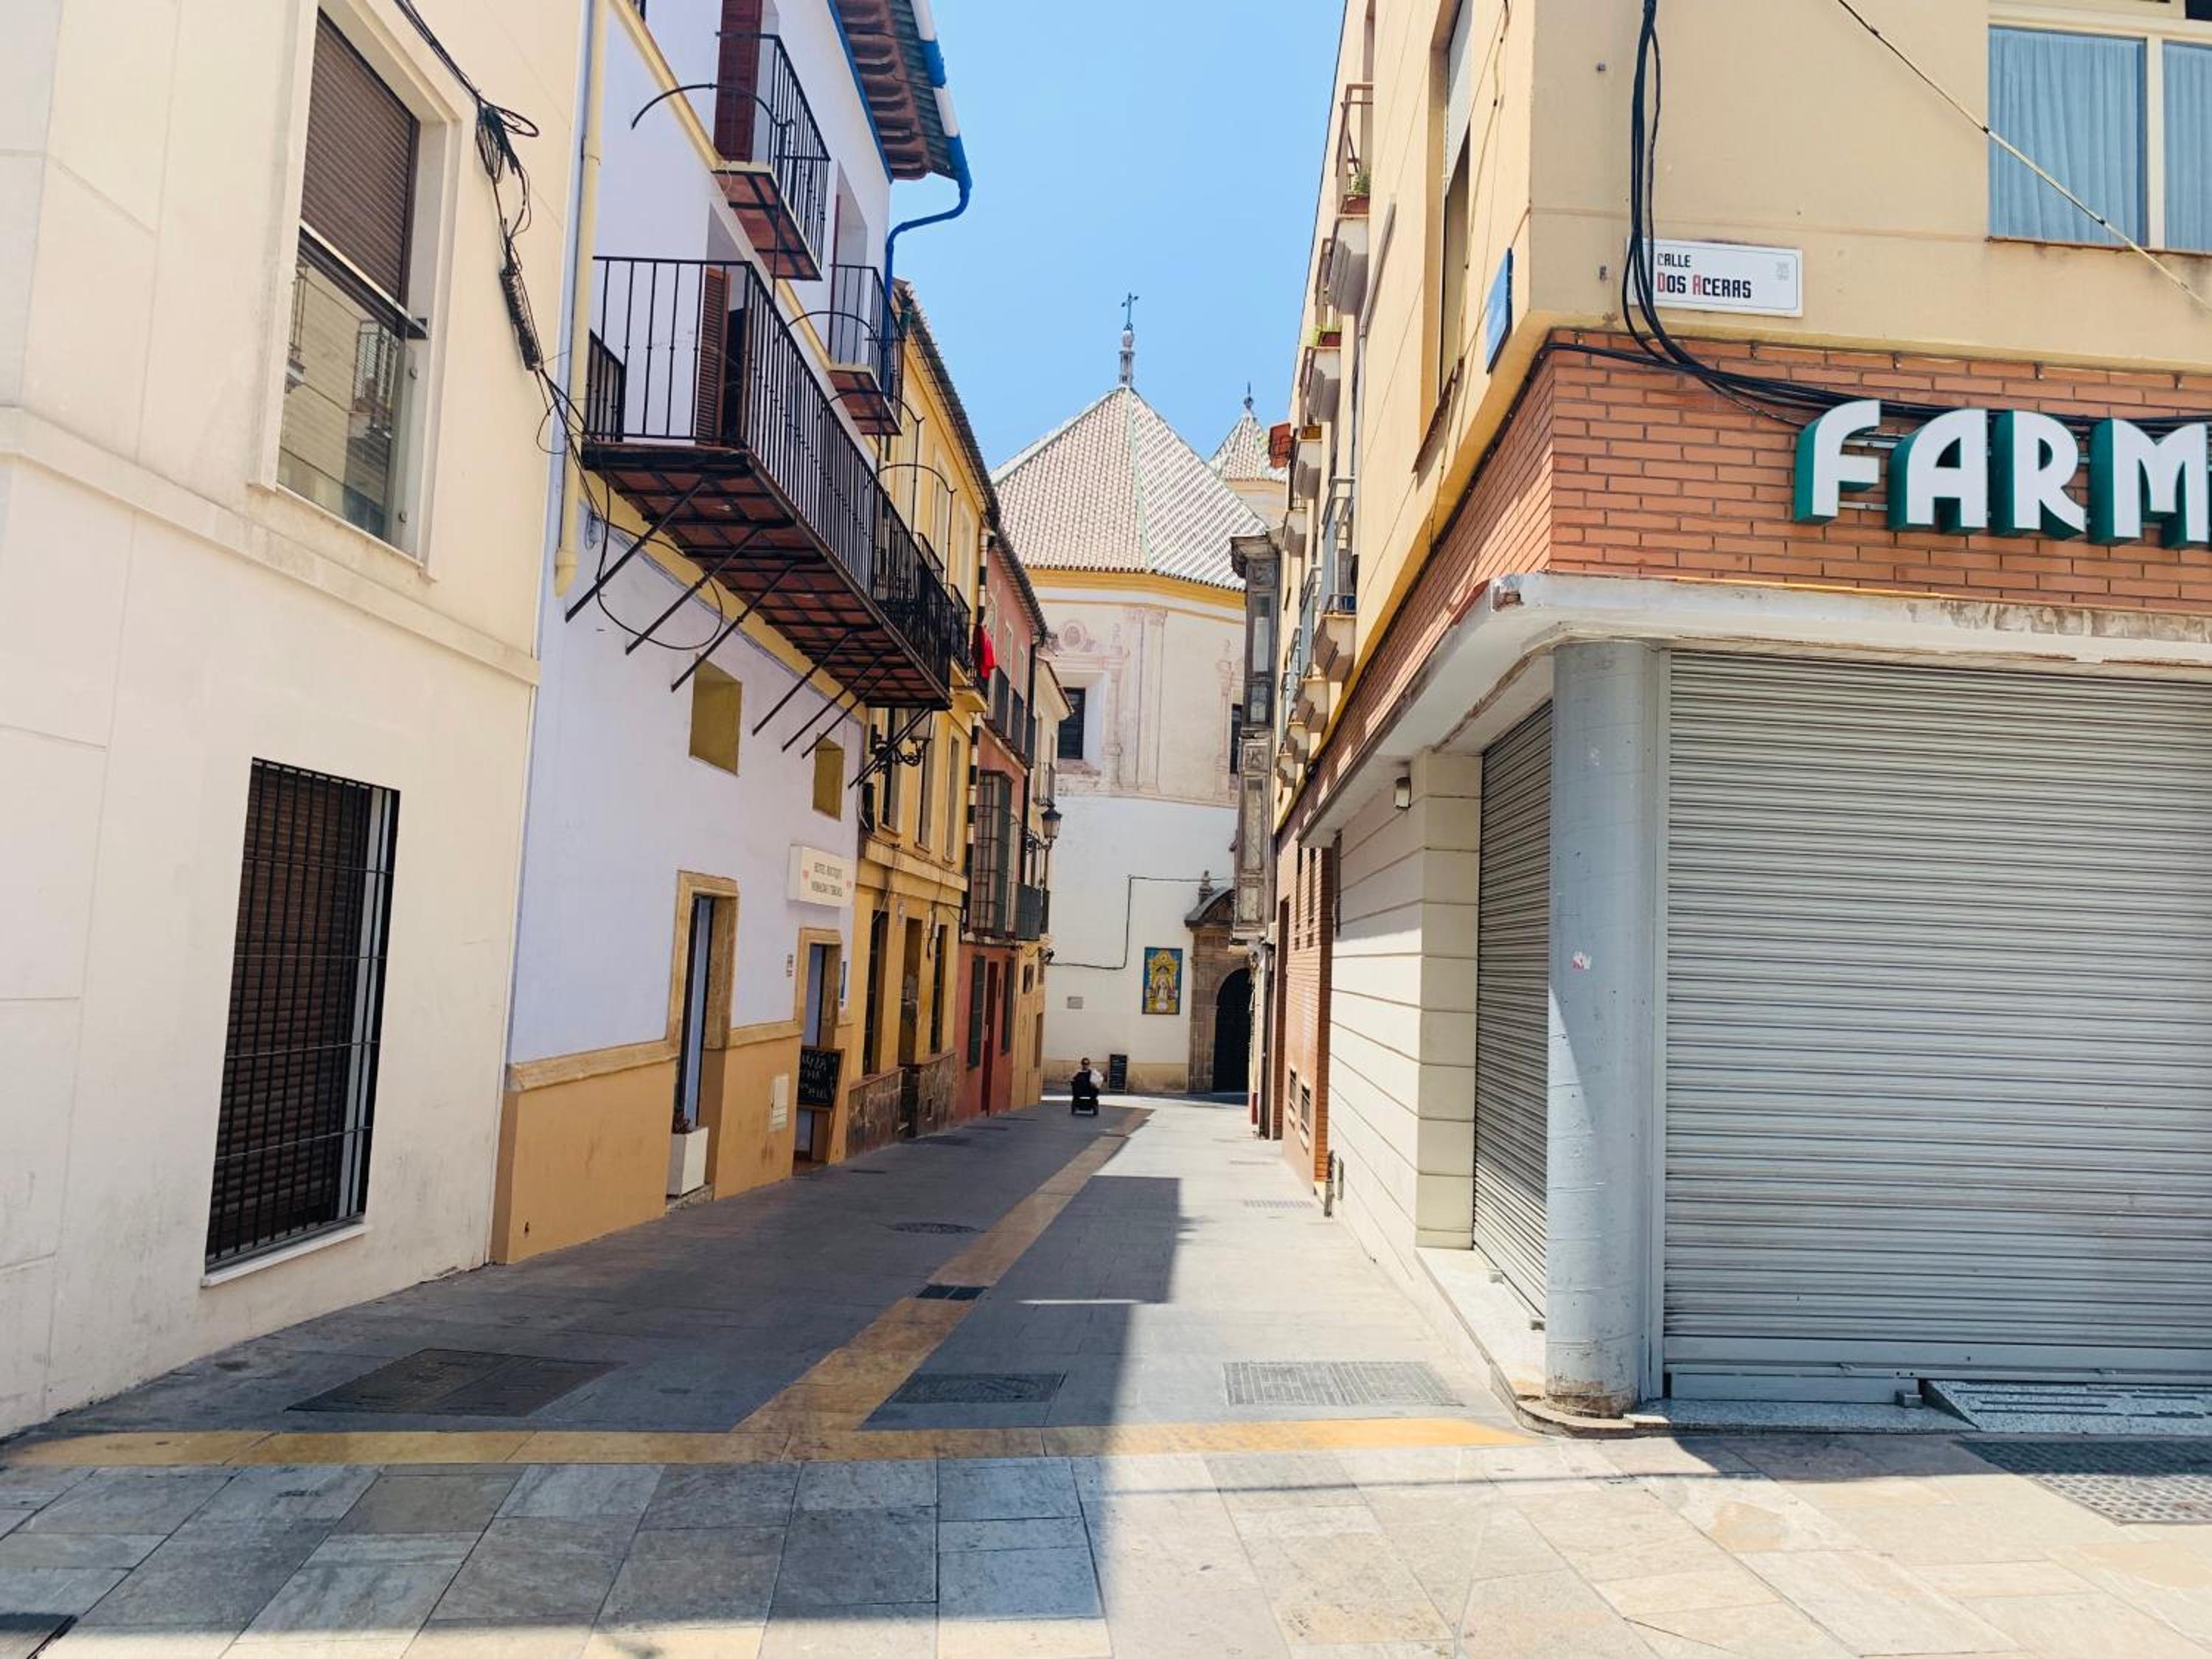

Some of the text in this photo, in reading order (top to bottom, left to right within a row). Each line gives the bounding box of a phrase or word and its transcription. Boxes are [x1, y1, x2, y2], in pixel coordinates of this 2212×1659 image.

[1657, 253, 1691, 268] CALLE
[1657, 272, 1751, 299] DOS ACERAS
[1795, 399, 2209, 547] FARM
